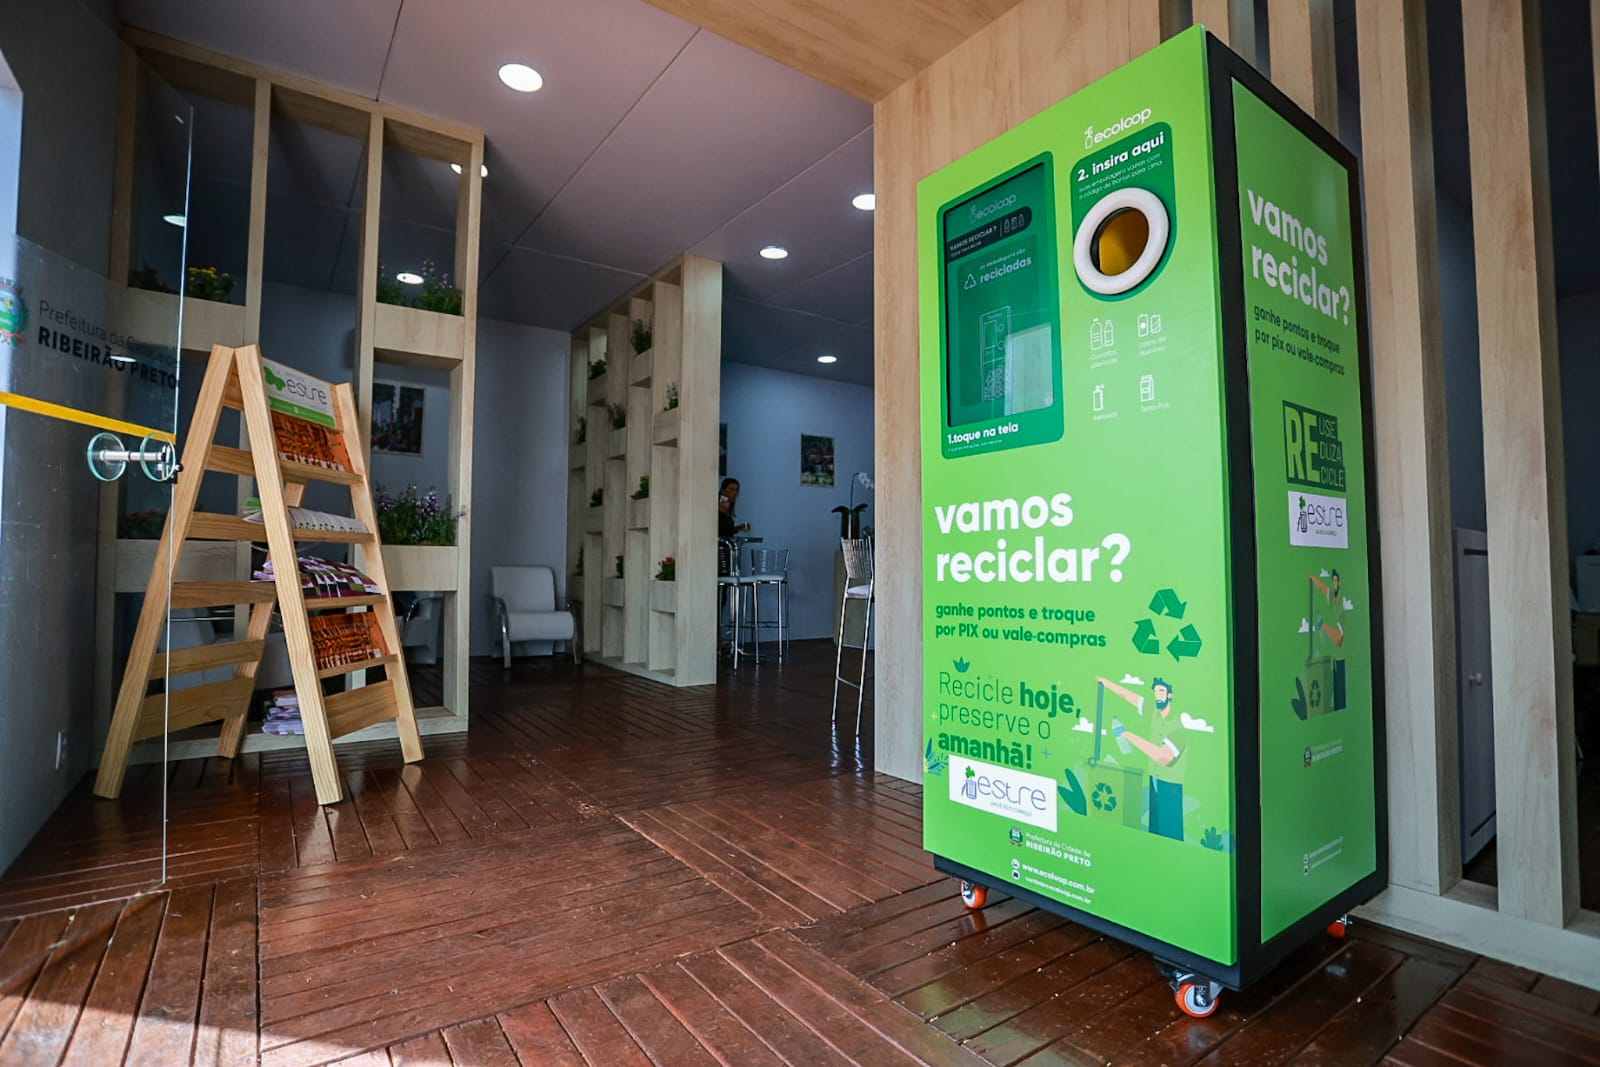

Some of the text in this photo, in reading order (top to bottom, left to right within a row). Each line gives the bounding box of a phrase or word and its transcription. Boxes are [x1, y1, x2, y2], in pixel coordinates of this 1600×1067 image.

[1094, 108, 1152, 143] ecoloop
[1077, 131, 1165, 182] 2. insira aqui
[976, 194, 1017, 219] ecoloop
[1247, 188, 1329, 266] vamos
[980, 257, 1032, 283] recicladas
[1251, 244, 1350, 327] reciclar?
[39, 300, 125, 347] Prefeitura da
[1254, 304, 1340, 355] ganhe pontos e troque
[38, 327, 125, 371] RIBEIRÃO
[130, 361, 178, 390] PRETO
[1255, 327, 1345, 376] por pix ou vale-compras
[983, 428, 996, 438] na
[998, 422, 1019, 435] tela
[1284, 405, 1321, 483] RE
[1319, 417, 1336, 439] USE
[1319, 441, 1343, 464] DUZA
[1320, 466, 1344, 488] CICLE
[934, 492, 1074, 535] vamos
[1307, 504, 1343, 527] estre
[936, 532, 1131, 584] reciclar?
[935, 602, 1096, 625] ganhe pontos e troque
[935, 623, 1106, 648] por PIX ou vale-compras
[939, 671, 1081, 719] Recicle hoje,
[939, 703, 1051, 740] preserve o
[938, 732, 1033, 770] amanhã!
[977, 775, 1047, 811] estre
[1025, 840, 1092, 868] RIBEIRÃO PRETO
